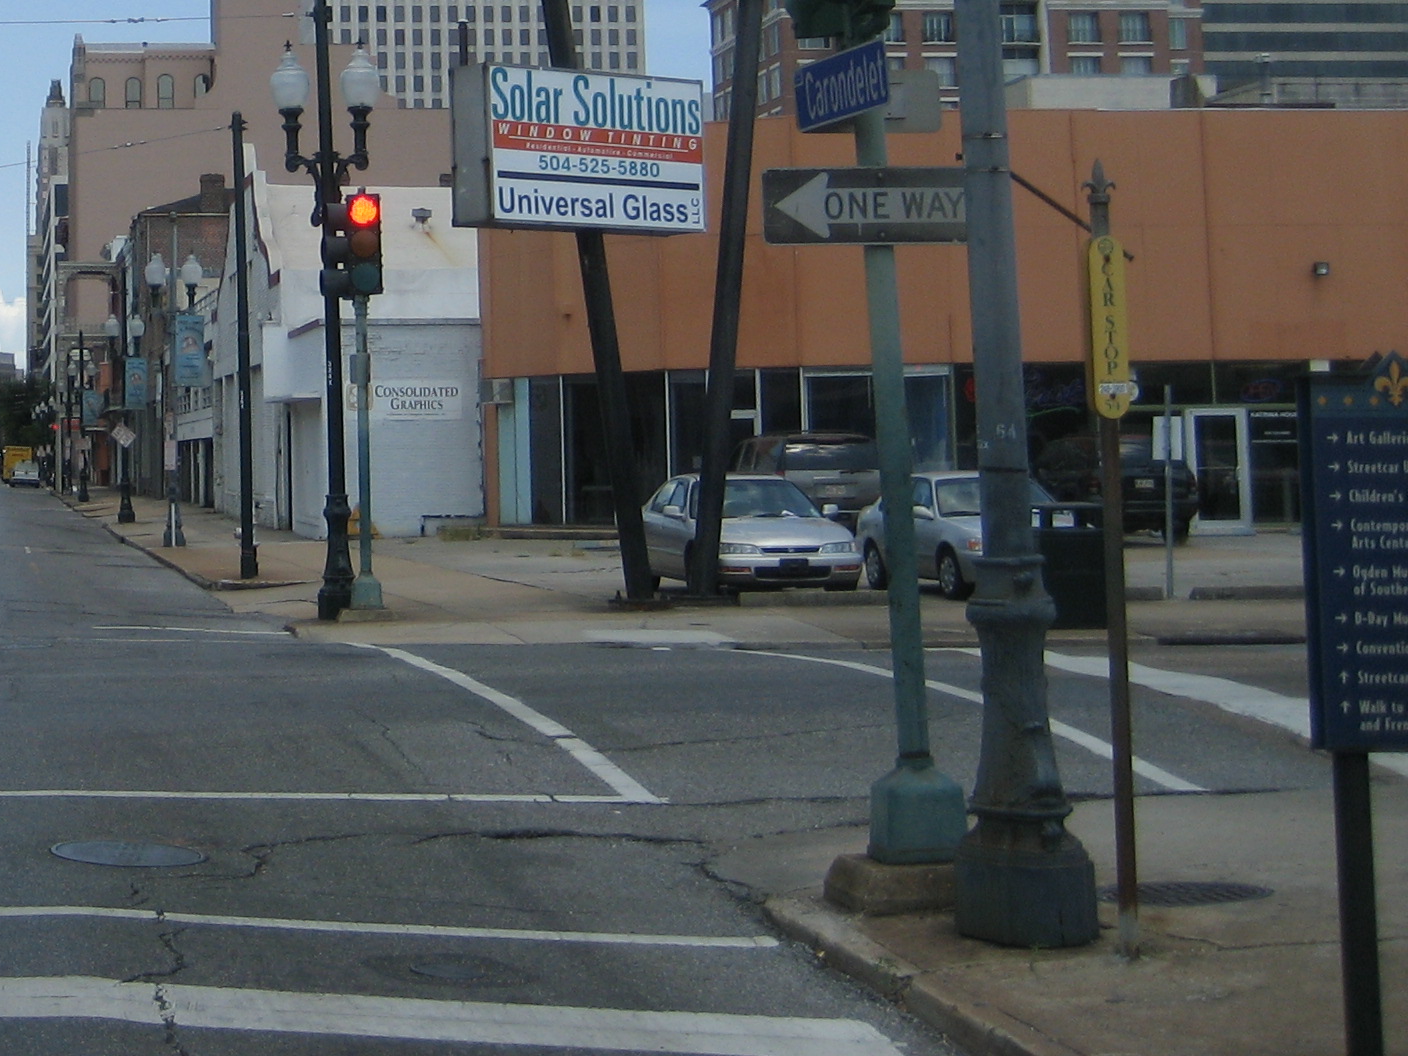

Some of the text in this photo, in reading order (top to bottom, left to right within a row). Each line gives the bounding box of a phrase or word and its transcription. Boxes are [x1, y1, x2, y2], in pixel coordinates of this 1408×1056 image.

[804, 49, 887, 120] Carondelet
[492, 66, 700, 135] Solar Solutions
[497, 122, 698, 151] WINDOW TINTING
[525, 142, 572, 153] Residential
[626, 149, 674, 160] Commercial
[538, 154, 661, 178] 504-525-5880
[497, 185, 689, 224] Universal Glass
[691, 197, 700, 225] LLC
[824, 191, 965, 220] ONE WAY
[1103, 315, 1119, 376] STOP
[374, 384, 459, 398] CONSOLIDATED
[390, 397, 444, 411] GRAPHICS
[1346, 429, 1365, 445] Art
[1347, 459, 1399, 474] Streetcar
[1349, 488, 1404, 504] Children's
[1352, 535, 1376, 549] Arts
[1352, 564, 1389, 582] Ogden
[1353, 581, 1366, 596] of
[1354, 611, 1389, 627] D-Day
[1359, 699, 1404, 714] Walk to
[1360, 717, 1381, 732] and
